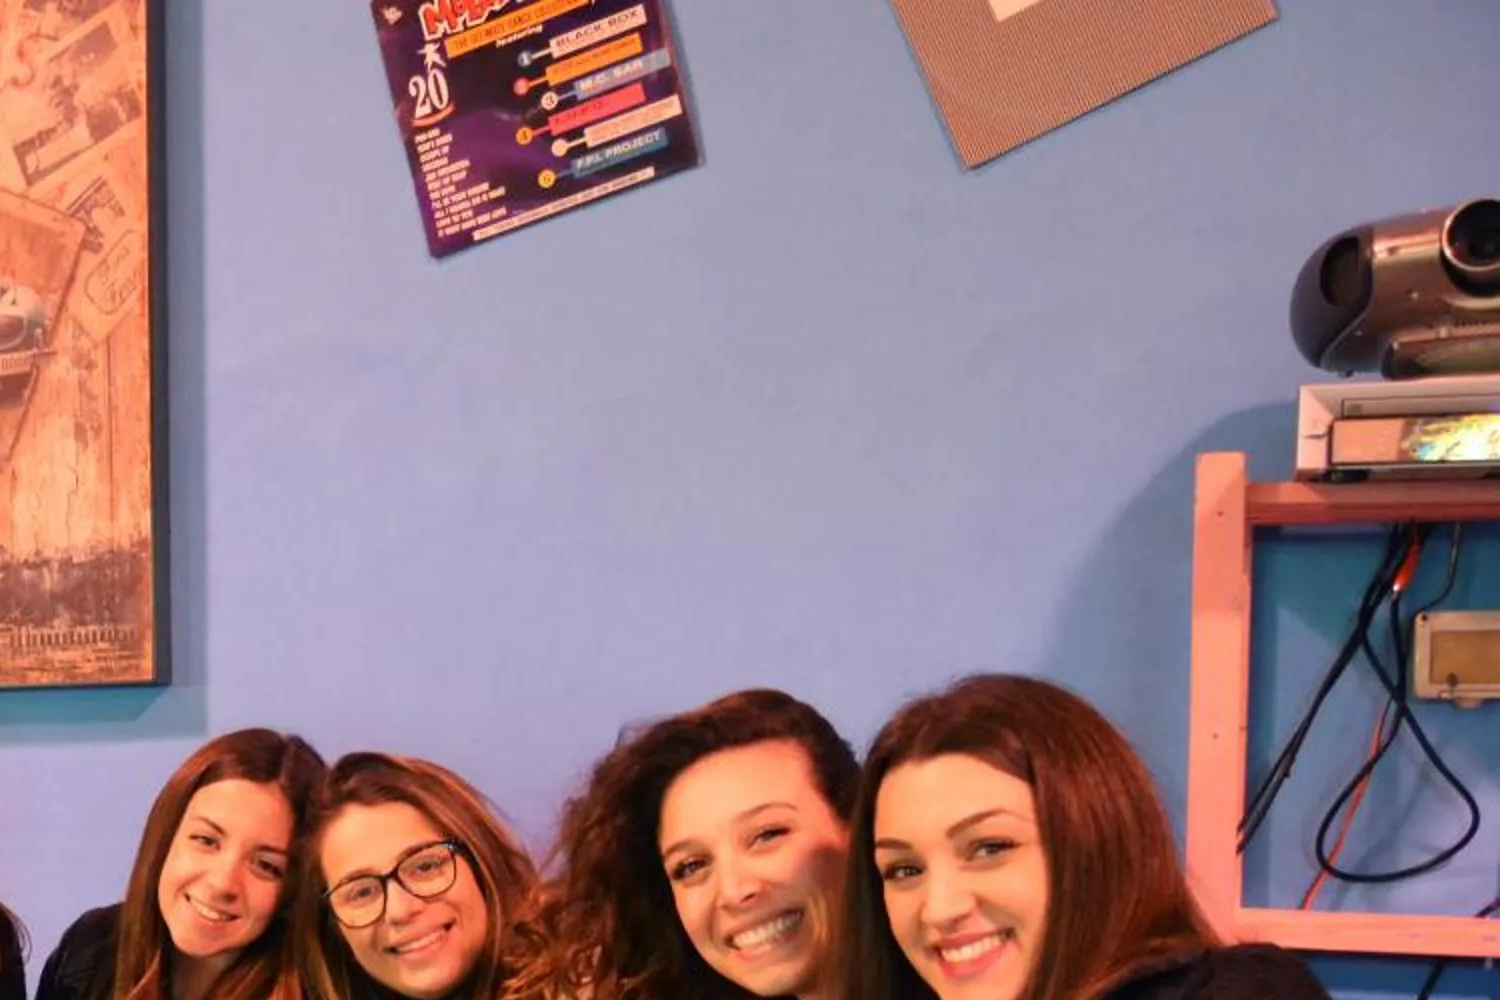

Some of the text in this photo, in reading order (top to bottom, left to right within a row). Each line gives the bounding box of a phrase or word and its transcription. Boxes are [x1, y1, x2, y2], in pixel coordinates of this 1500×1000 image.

[555, 9, 638, 47] BLACK BOX
[408, 68, 449, 119] 20
[605, 130, 661, 160] PROJECT
